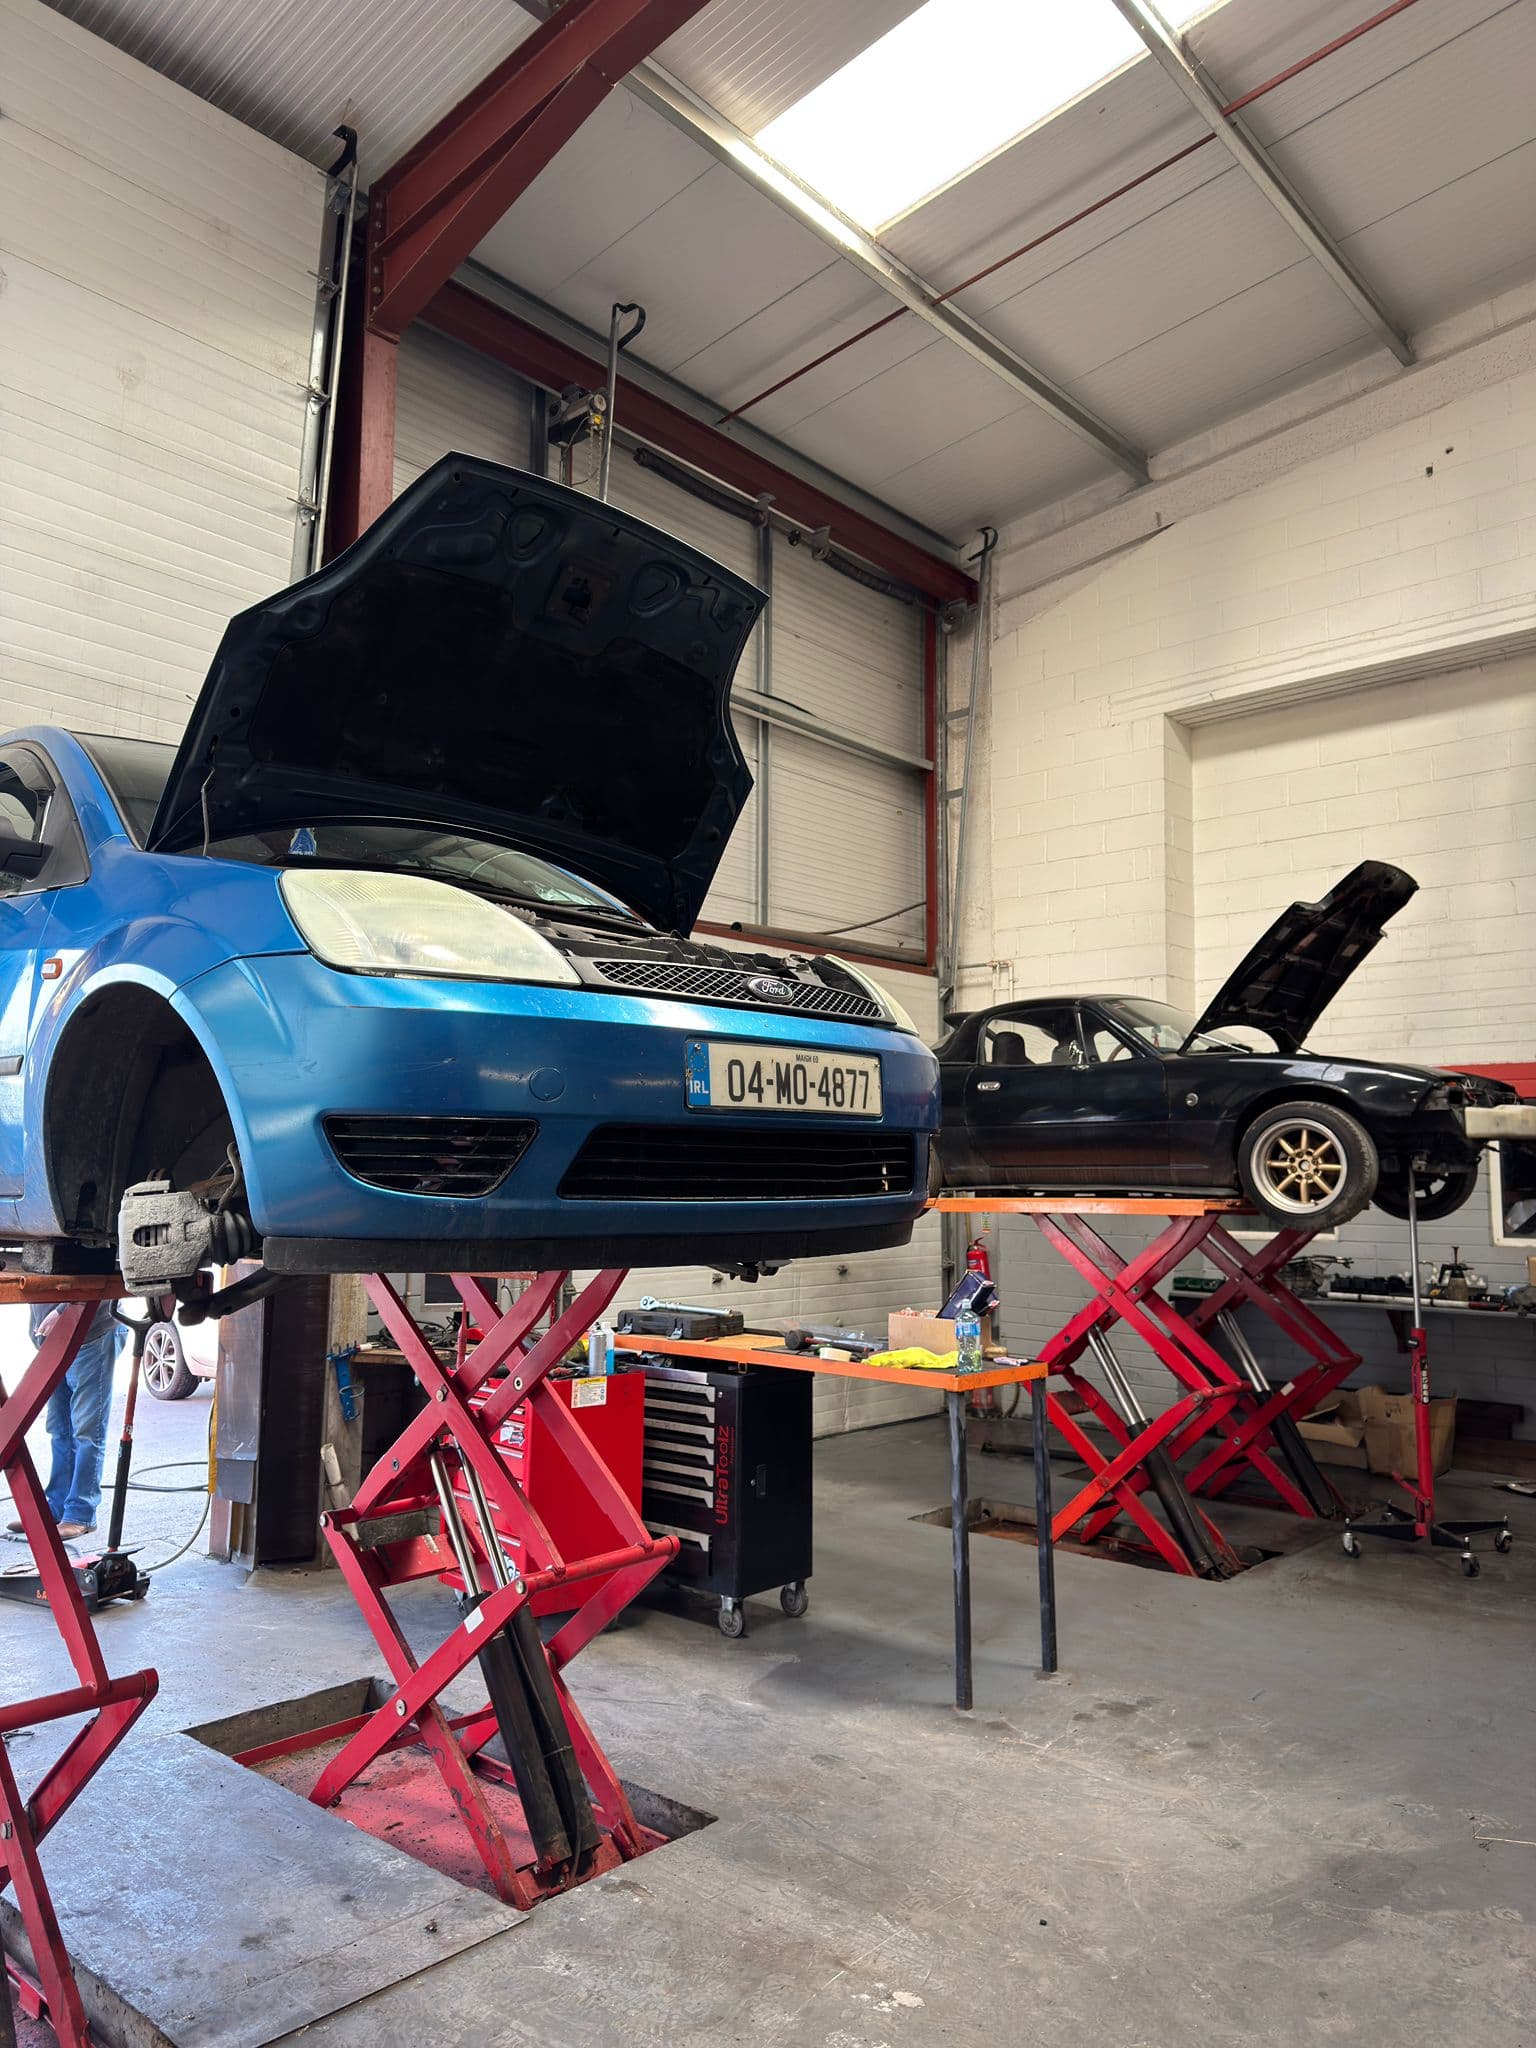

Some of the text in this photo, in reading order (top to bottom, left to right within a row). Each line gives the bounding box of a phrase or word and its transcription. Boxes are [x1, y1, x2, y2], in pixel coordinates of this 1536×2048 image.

[762, 981, 786, 995] Ford
[690, 1080, 710, 1094] IRL
[727, 1059, 869, 1109] 04-MO-4877
[715, 1425, 729, 1525] UltraToolz
